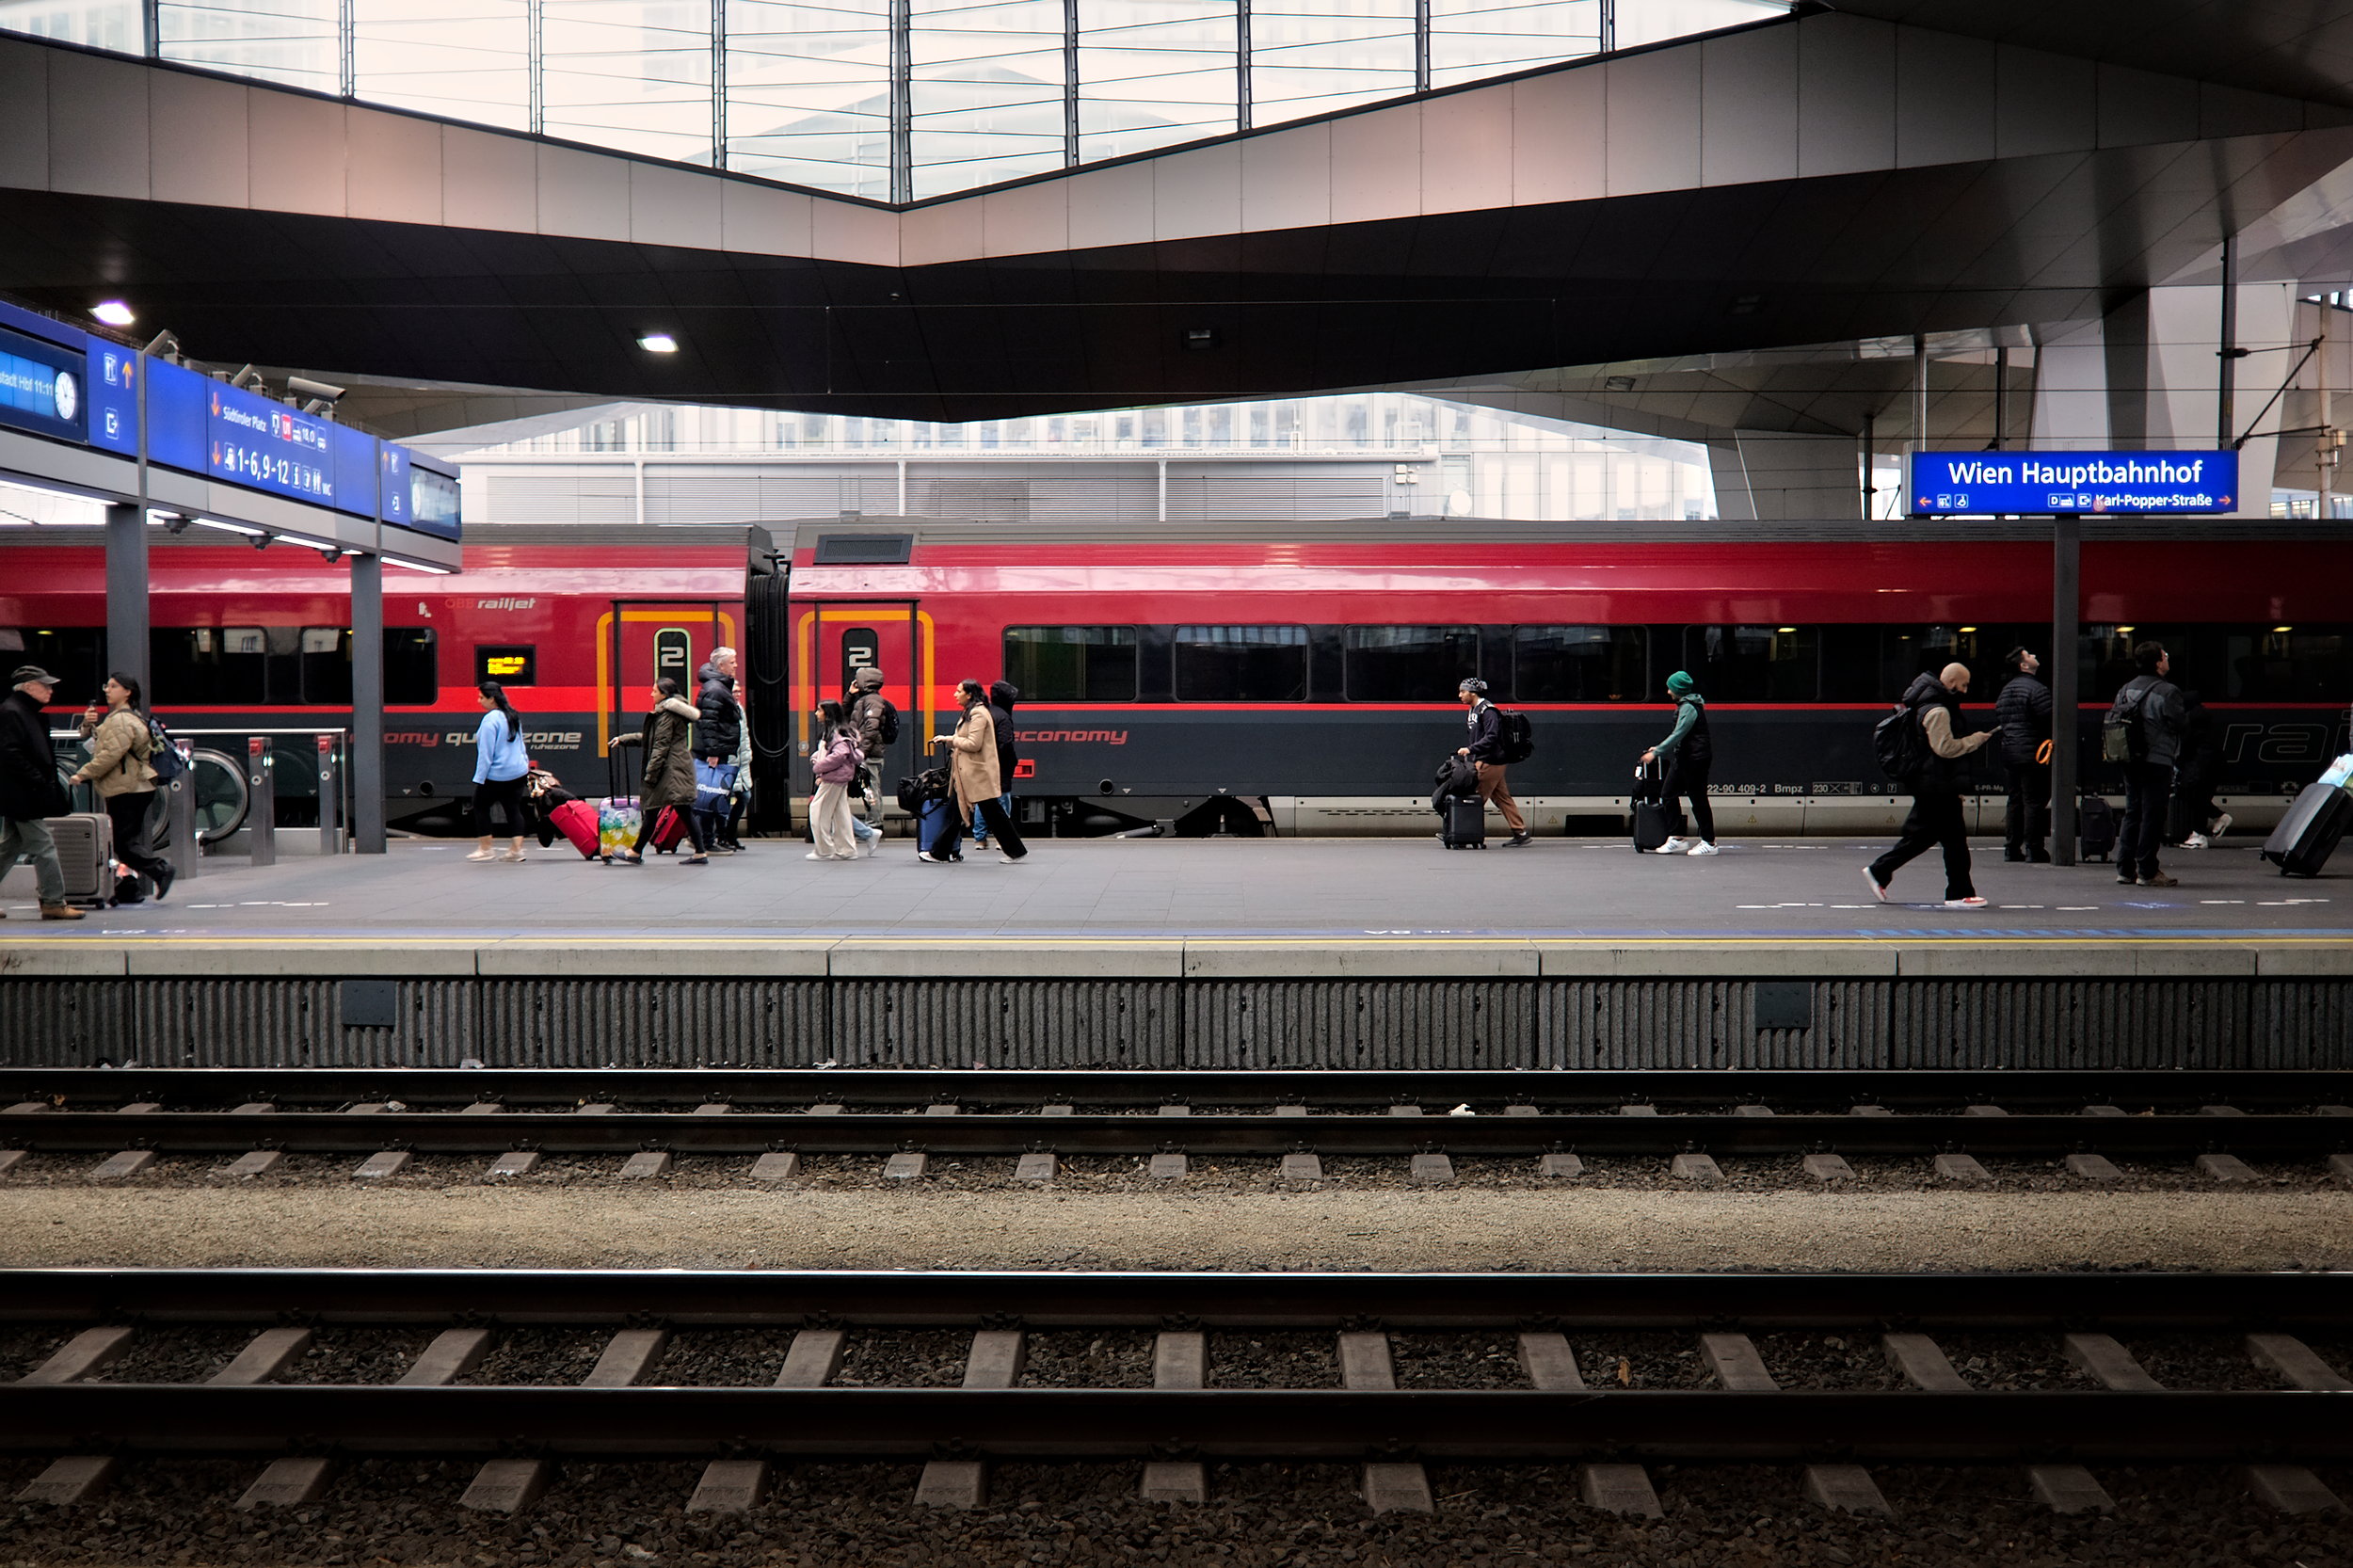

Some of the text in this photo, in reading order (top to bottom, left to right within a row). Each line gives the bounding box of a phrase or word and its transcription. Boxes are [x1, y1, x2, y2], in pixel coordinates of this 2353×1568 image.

[222, 406, 266, 433] Südtiroler Platz
[282, 420, 291, 435] U1
[1948, 459, 2203, 488] Wien Hauptbahnhof
[2095, 493, 2213, 509] Karl-Popper-Straße
[477, 597, 536, 612] railjet
[661, 647, 684, 667] 2
[848, 647, 872, 667] 2
[1774, 784, 1803, 794] Bmpz
[1813, 784, 1829, 793] 230
